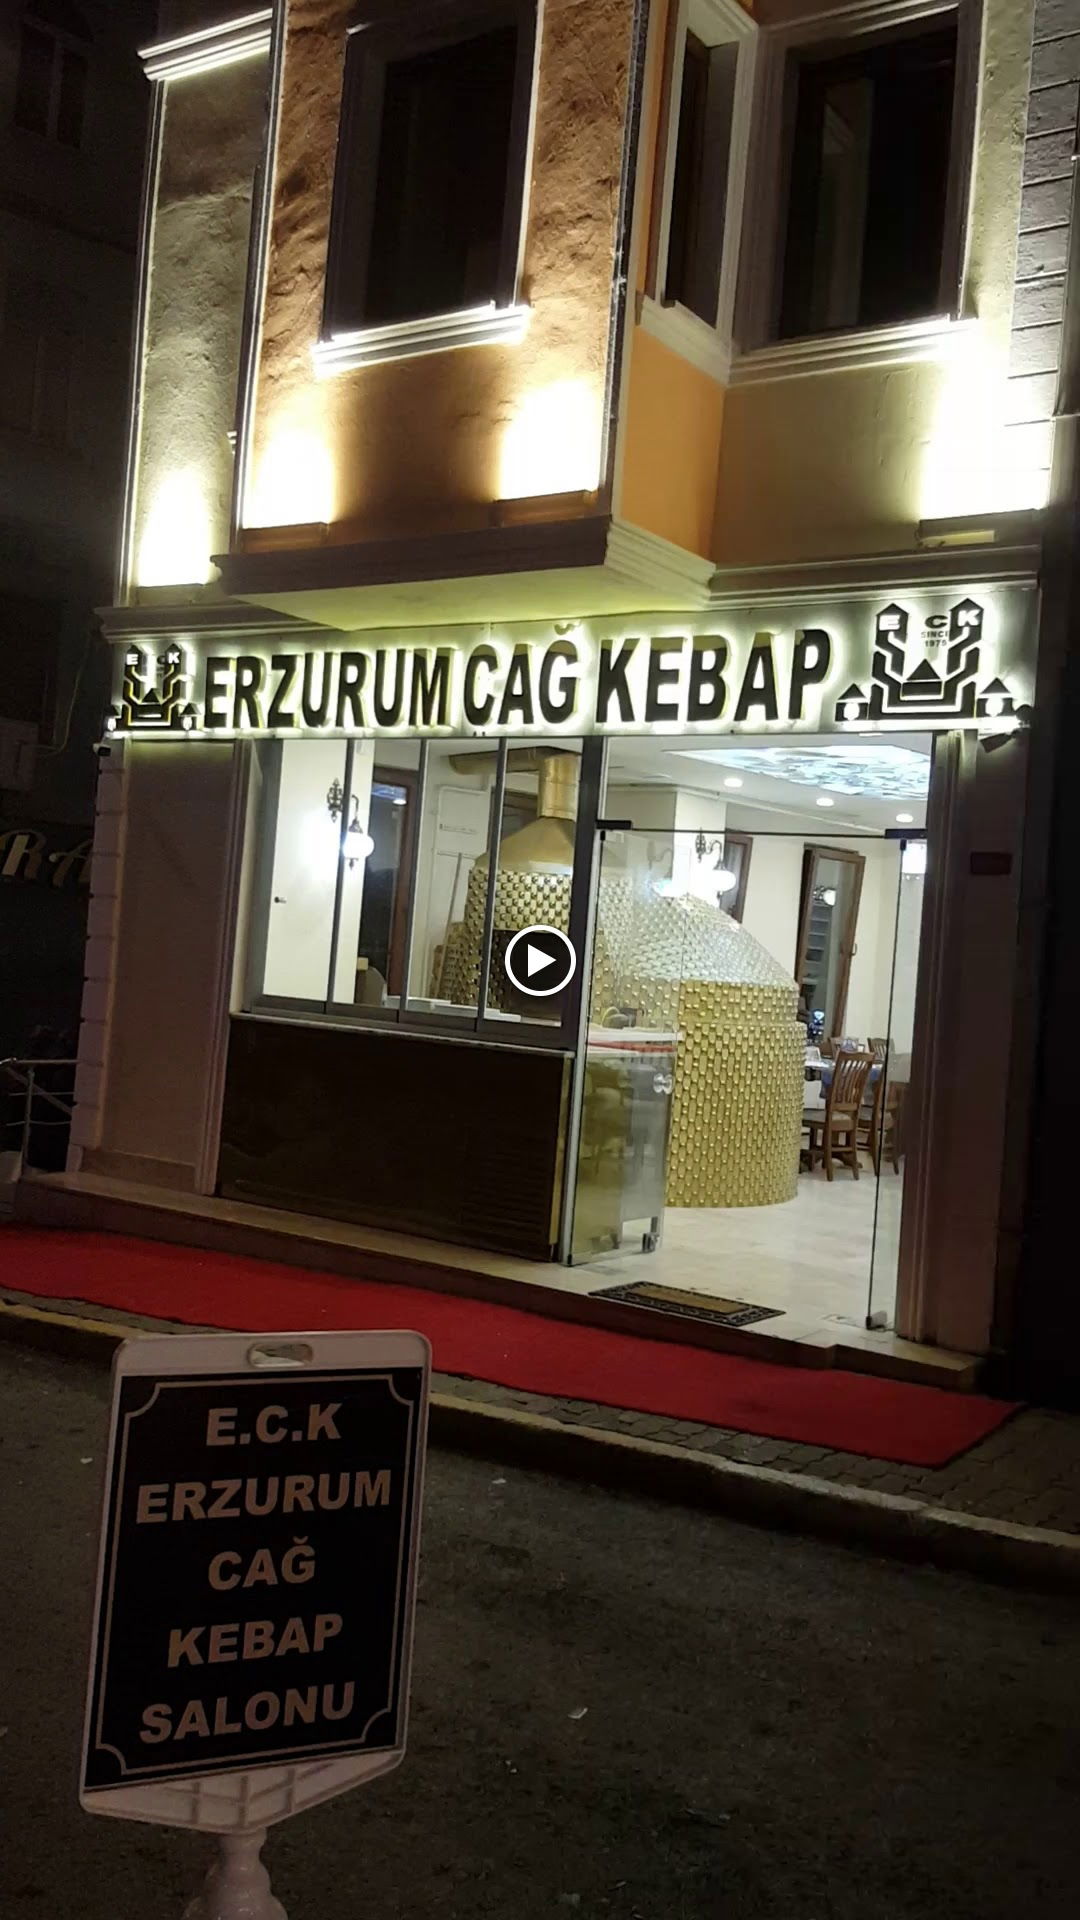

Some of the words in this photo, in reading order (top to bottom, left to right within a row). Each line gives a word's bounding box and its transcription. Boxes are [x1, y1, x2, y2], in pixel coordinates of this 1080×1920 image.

[879, 614, 900, 631] E
[925, 615, 948, 628] C
[957, 609, 980, 627] K
[126, 654, 138, 665] E
[168, 652, 180, 664] K
[204, 646, 452, 728] ERZURUM
[464, 623, 579, 726] CAĞ
[596, 629, 831, 723] KEBAP
[205, 1403, 342, 1446] E.C.K
[135, 1470, 391, 1524] ERZURUM
[207, 1536, 316, 1591] CAĞ
[167, 1614, 343, 1667] KEBAP
[139, 1681, 355, 1743] SALONU
